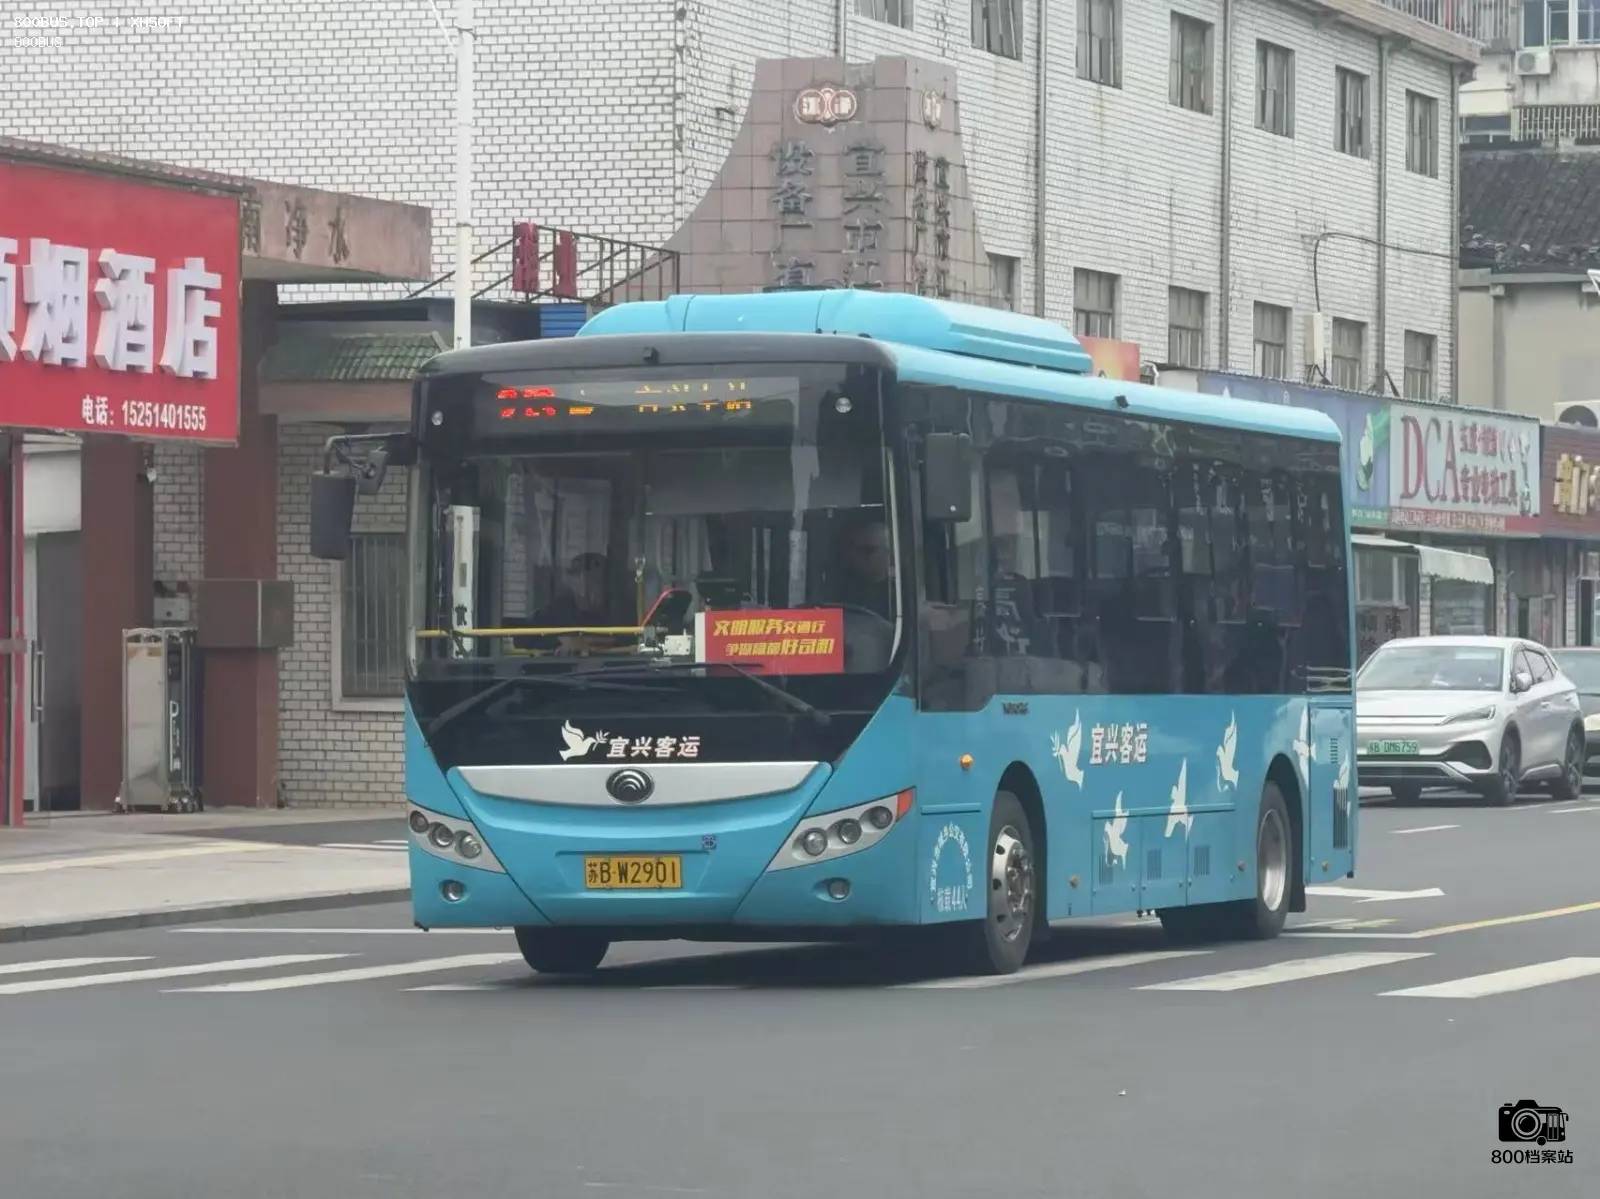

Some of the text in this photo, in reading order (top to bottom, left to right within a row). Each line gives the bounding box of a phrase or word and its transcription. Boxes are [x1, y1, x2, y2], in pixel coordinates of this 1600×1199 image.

[0, 236, 222, 380] 烟酒店
[1400, 414, 1460, 504] DCA
[606, 735, 701, 758] 宜兴客运
[1089, 723, 1149, 765] 宜兴客运
[587, 861, 677, 885] 苏B·W2901
